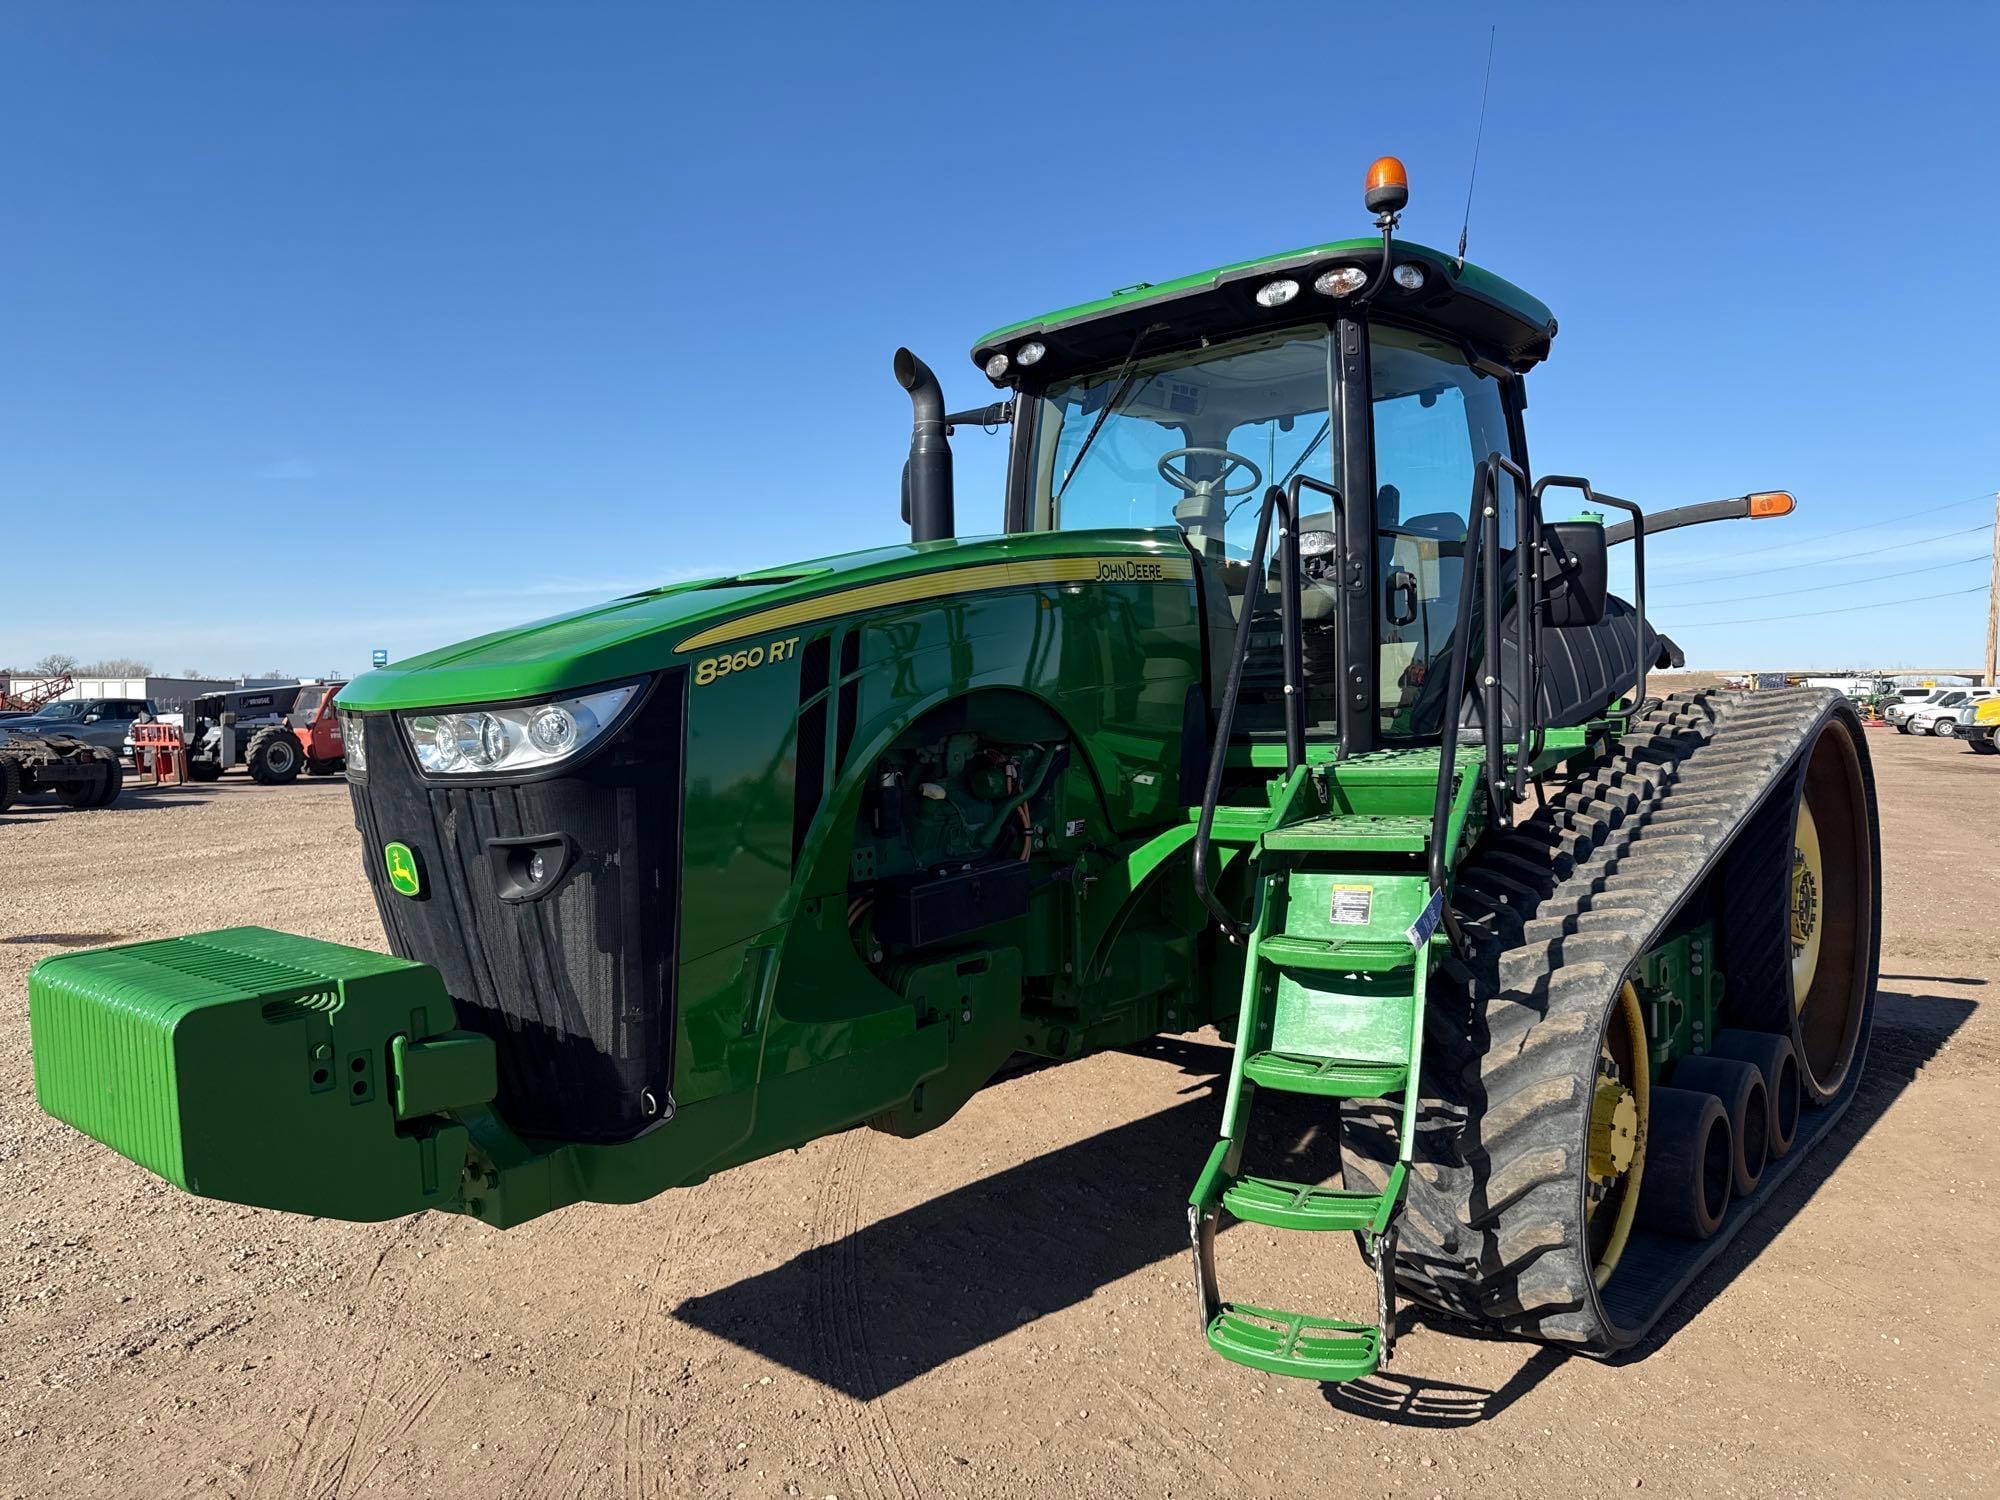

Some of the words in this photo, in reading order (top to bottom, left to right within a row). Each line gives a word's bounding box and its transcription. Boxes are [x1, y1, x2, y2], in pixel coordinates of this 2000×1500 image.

[1126, 560, 1163, 580] DEERE
[695, 646, 765, 686] 8360
[768, 636, 800, 664] RT
